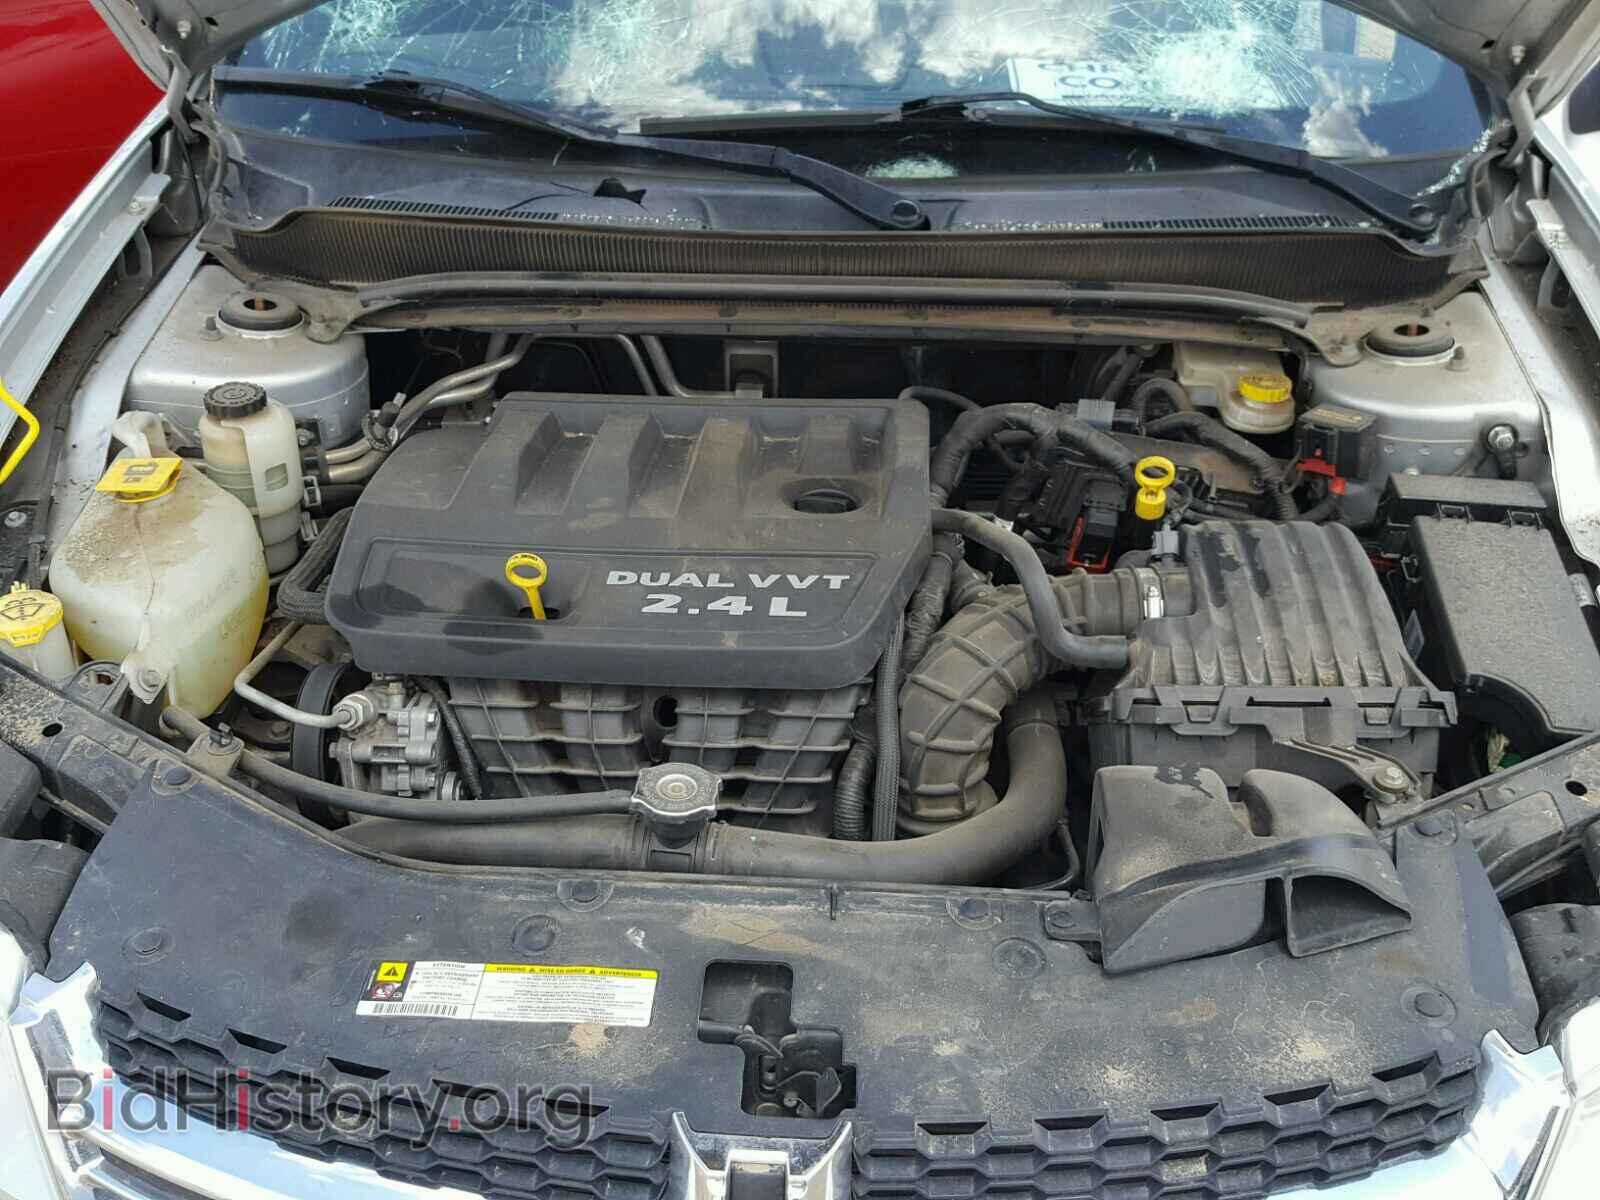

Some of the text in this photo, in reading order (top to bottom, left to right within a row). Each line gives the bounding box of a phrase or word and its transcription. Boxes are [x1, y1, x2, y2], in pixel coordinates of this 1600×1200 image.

[606, 570, 850, 589] DUAL VVT
[641, 593, 808, 617] 2.4 L
